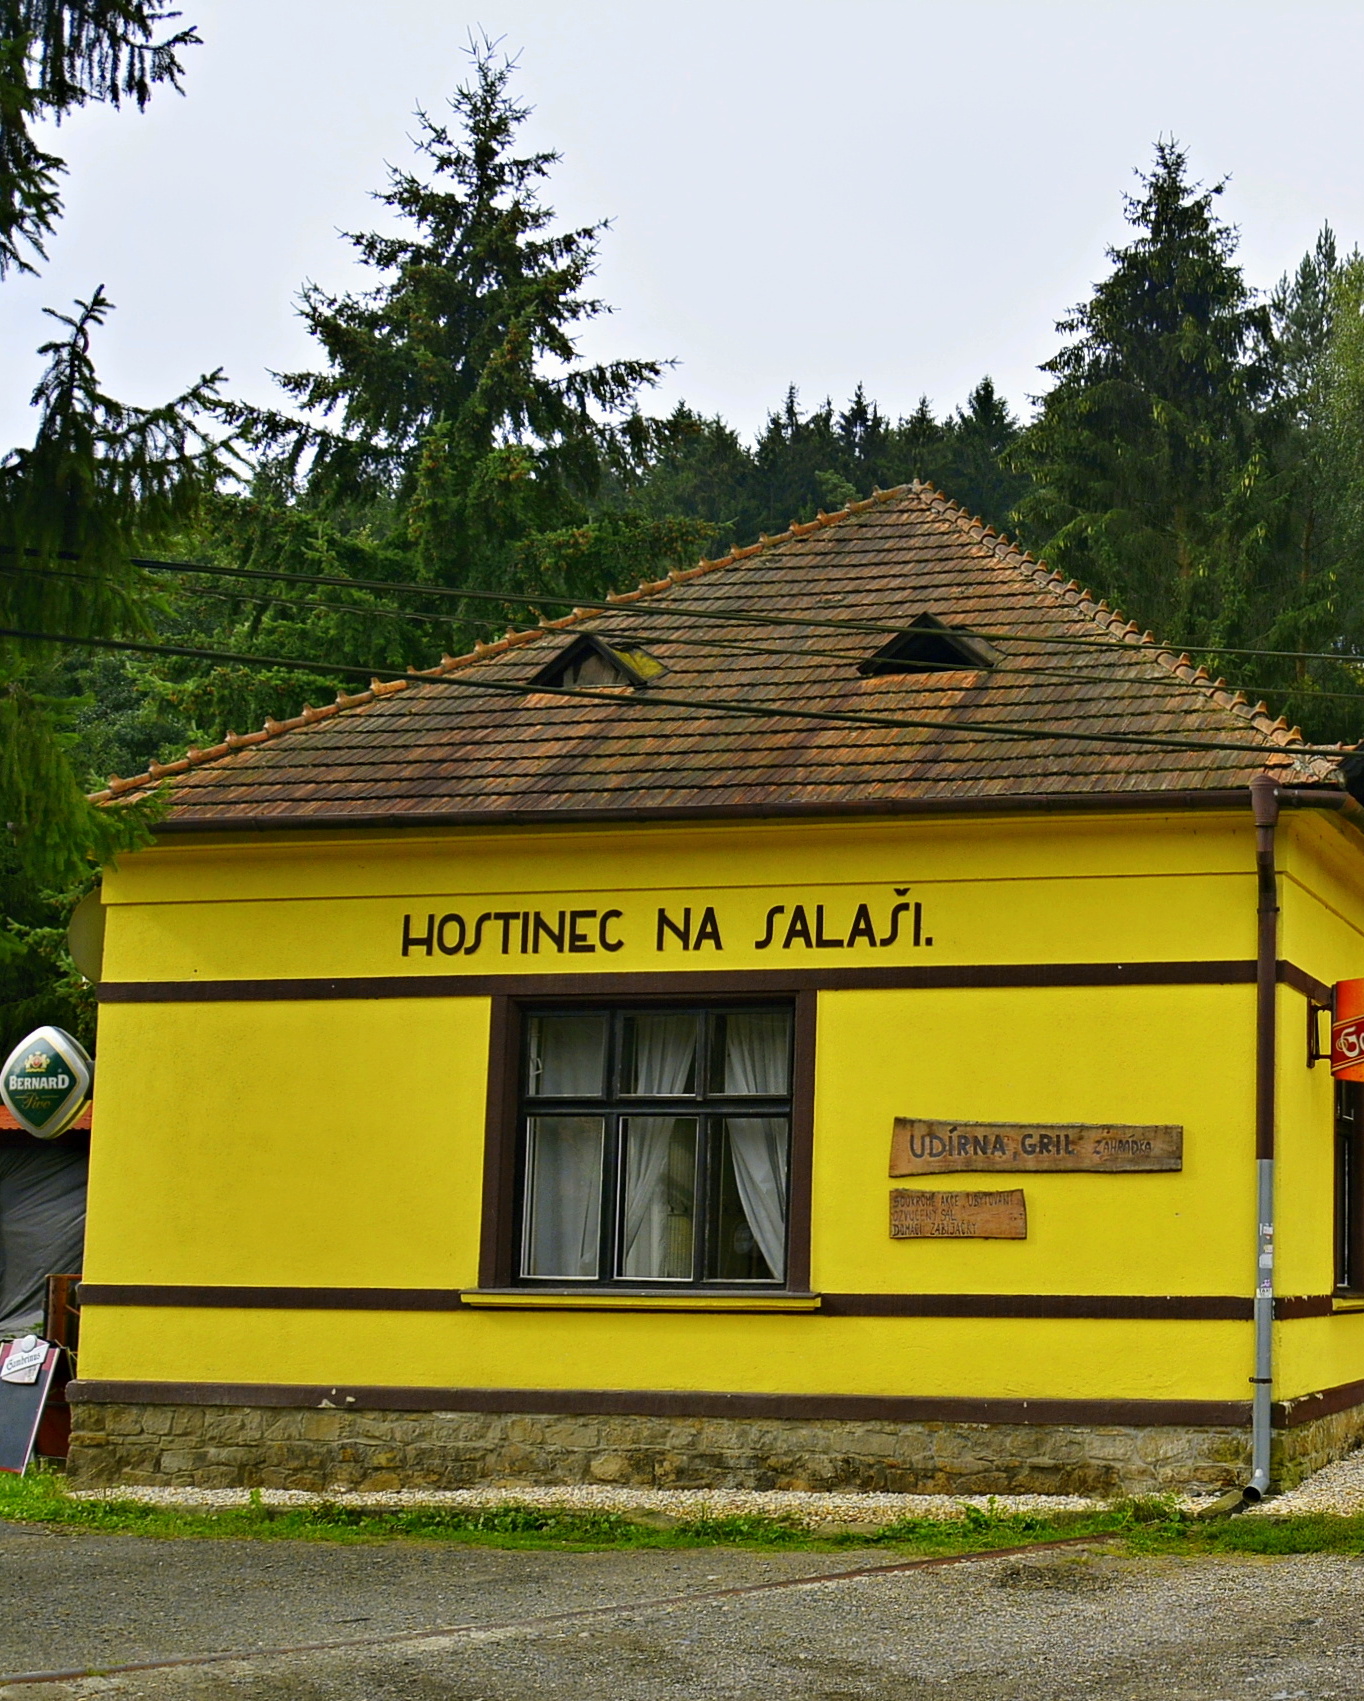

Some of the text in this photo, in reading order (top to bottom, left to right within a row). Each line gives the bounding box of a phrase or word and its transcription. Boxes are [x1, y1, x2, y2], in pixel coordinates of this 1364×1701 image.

[402, 909, 625, 957] HOSTINEC
[657, 906, 724, 952] NA
[9, 1074, 70, 1091] BERNARD
[1020, 1133, 1077, 1155] GRIL
